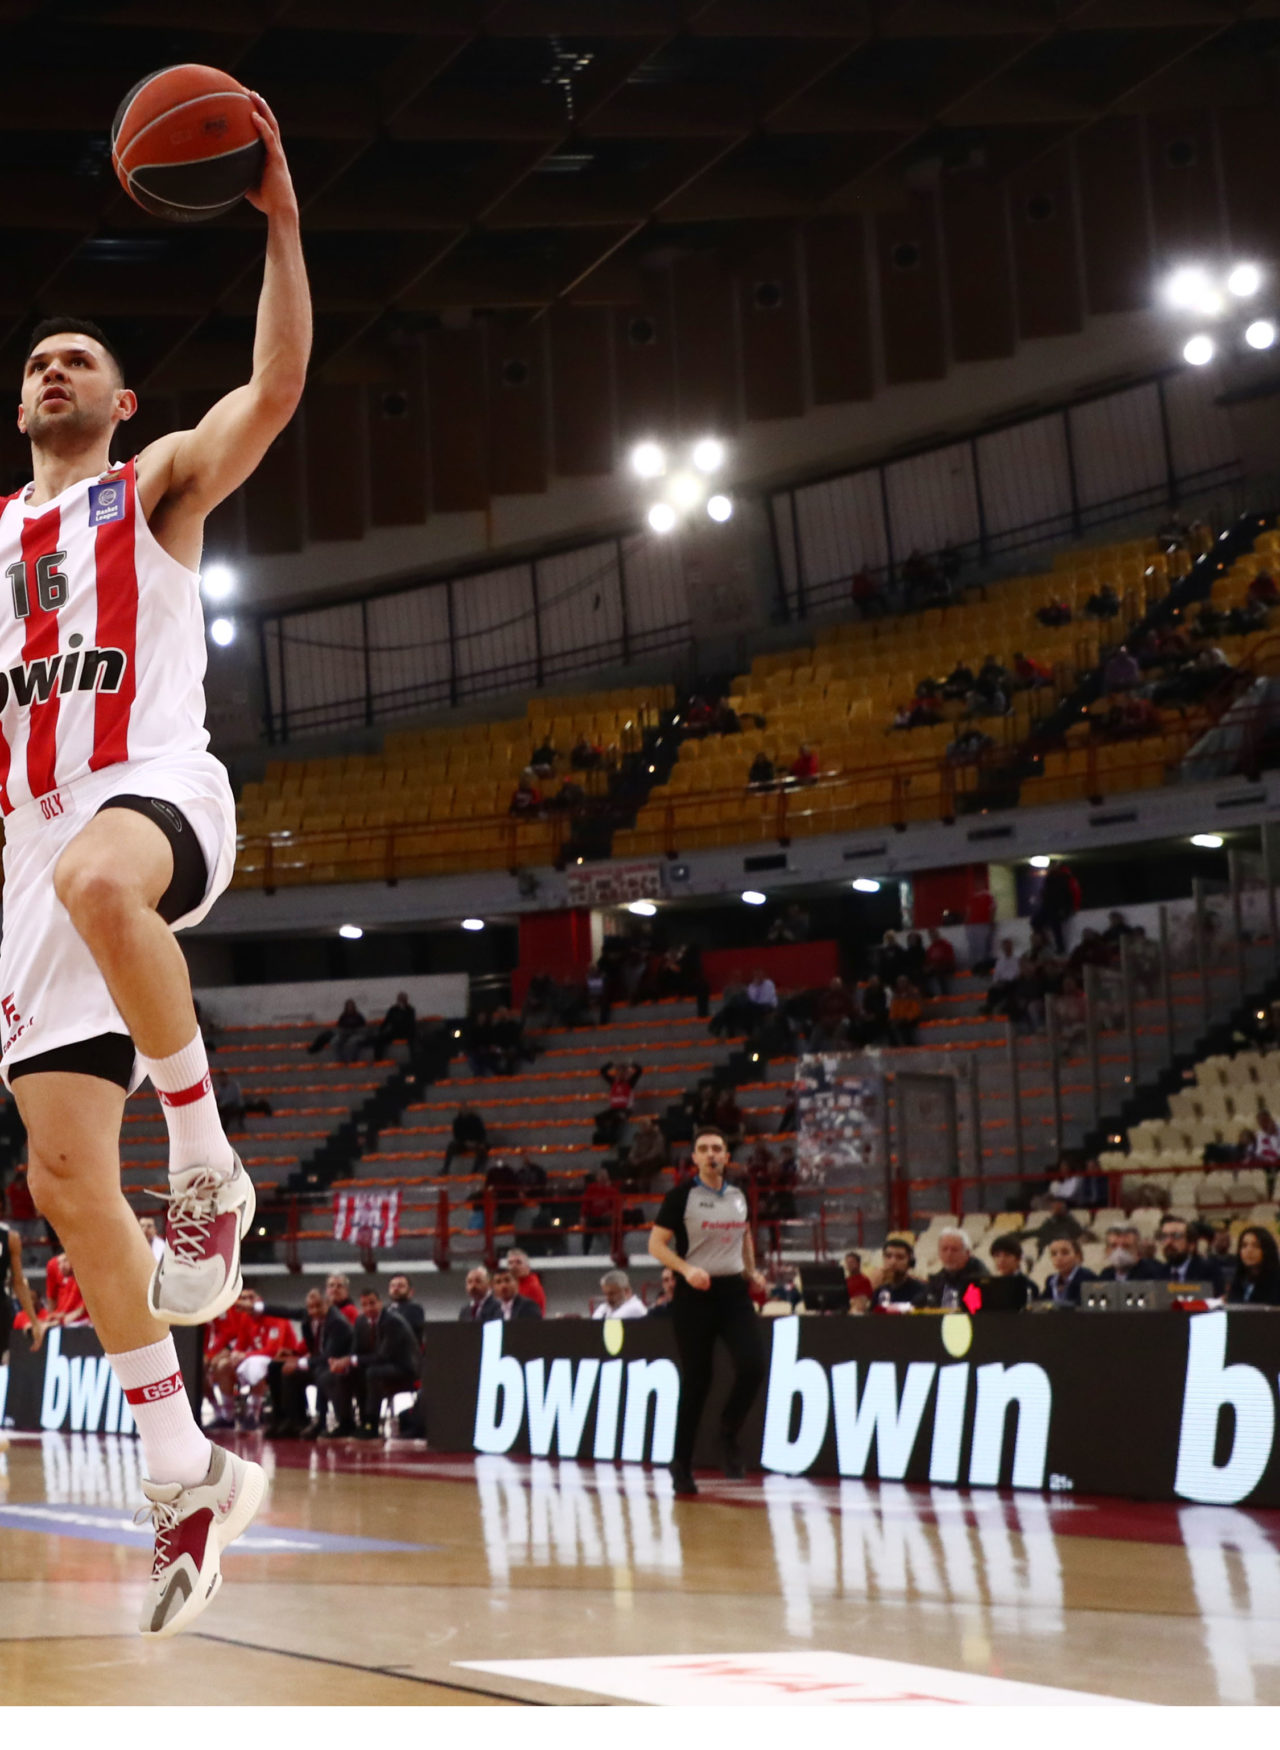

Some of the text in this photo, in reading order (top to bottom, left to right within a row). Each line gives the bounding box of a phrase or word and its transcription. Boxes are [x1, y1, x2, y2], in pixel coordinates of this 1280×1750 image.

[95, 505, 119, 516] Basket
[95, 511, 119, 522] League
[5, 551, 70, 619] 16
[40, 793, 65, 820] OLY
[473, 1319, 680, 1464] bwin
[761, 1315, 1052, 1489] bwin
